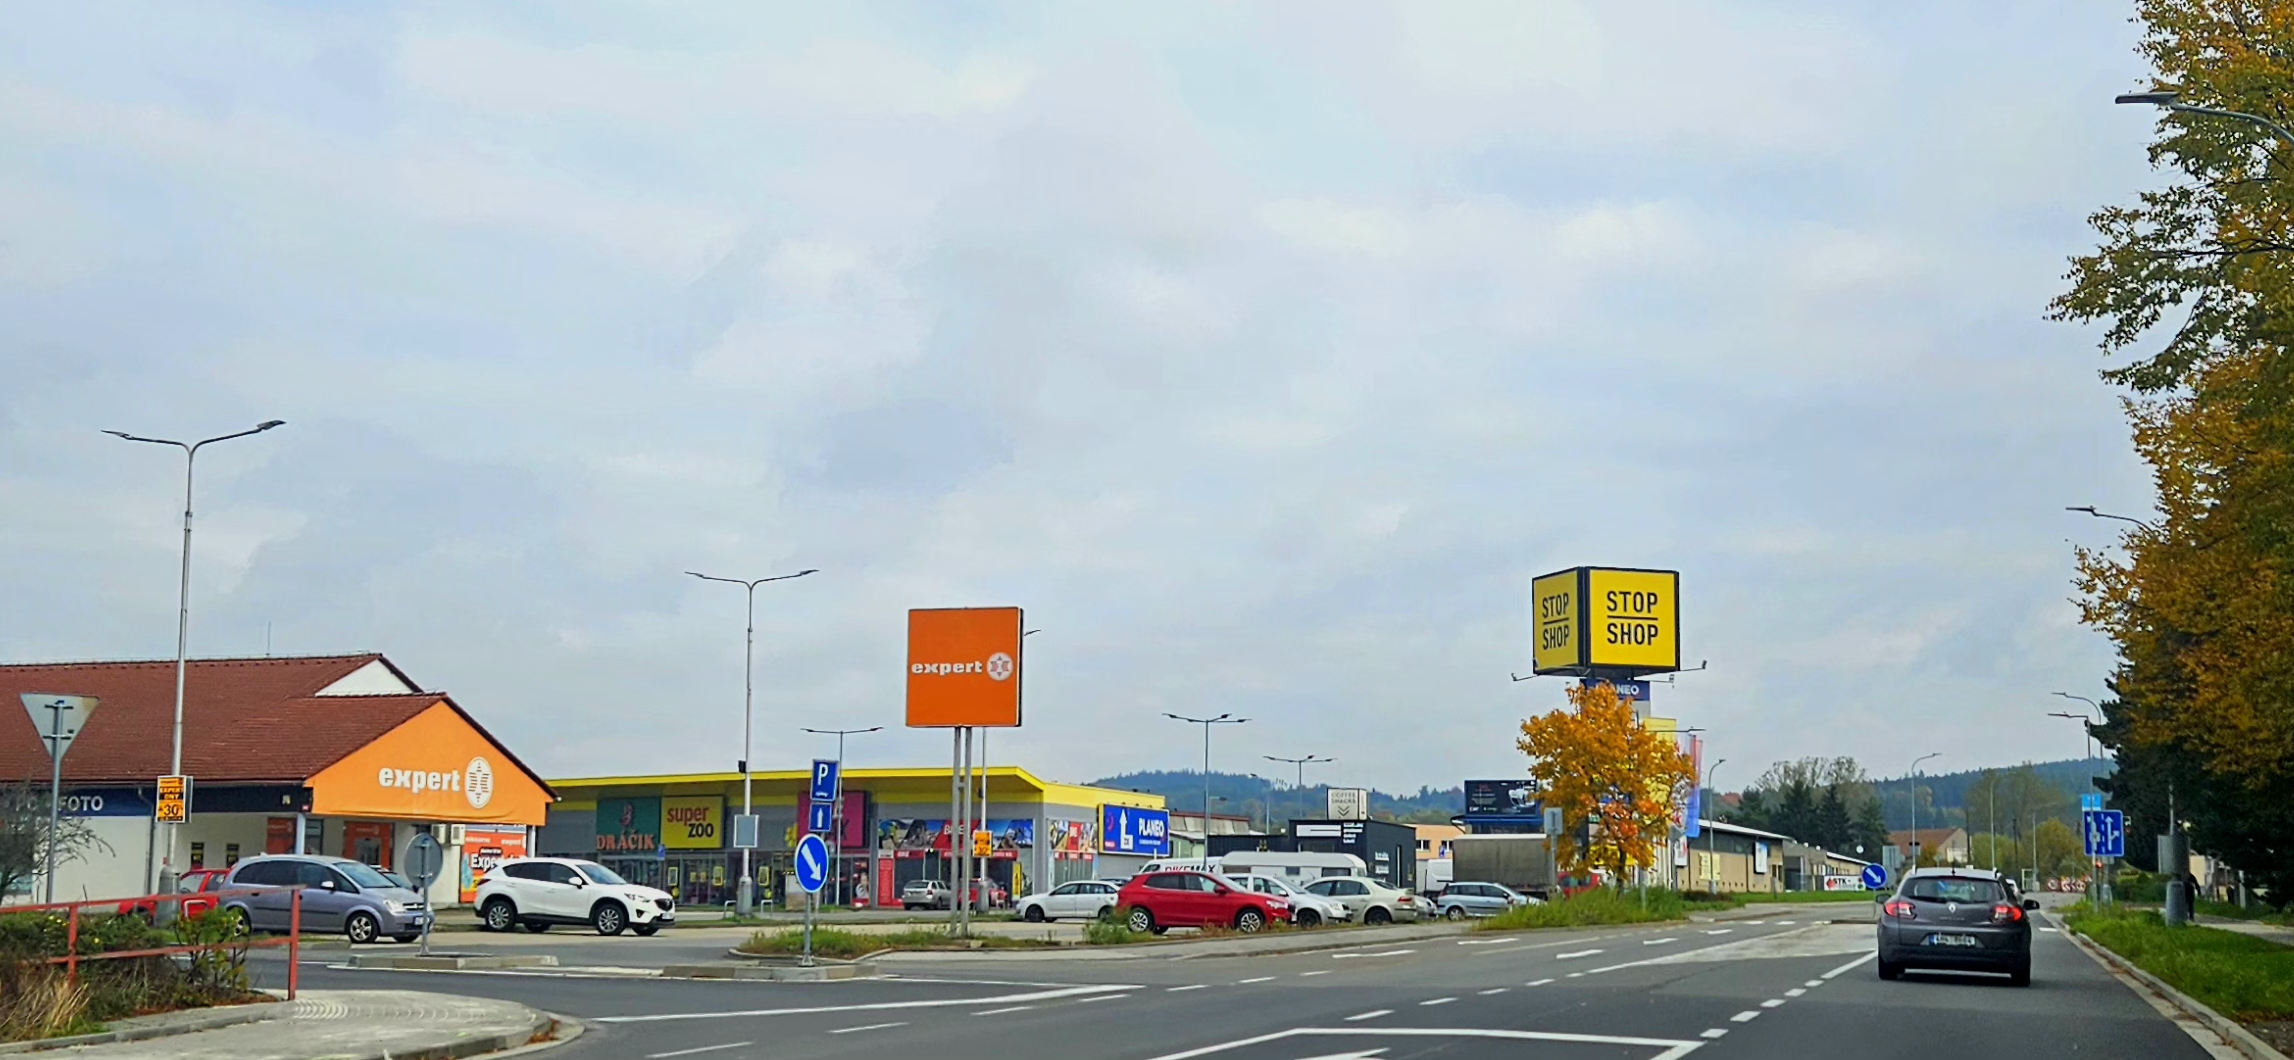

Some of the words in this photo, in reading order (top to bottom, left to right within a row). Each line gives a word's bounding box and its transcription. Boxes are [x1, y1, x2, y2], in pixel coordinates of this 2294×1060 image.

[1542, 592, 1570, 618] STOP
[1606, 591, 1658, 613] STOP
[1542, 625, 1570, 650] SHOP
[1606, 622, 1659, 646] SHOP
[911, 660, 983, 676] expert
[378, 767, 461, 794] expert
[817, 763, 829, 786] P
[57, 795, 104, 812] FOTO
[666, 807, 710, 827] super
[687, 823, 714, 838] ZOO
[1138, 818, 1165, 838] PLANEO
[596, 830, 655, 850] DRÁČIK
